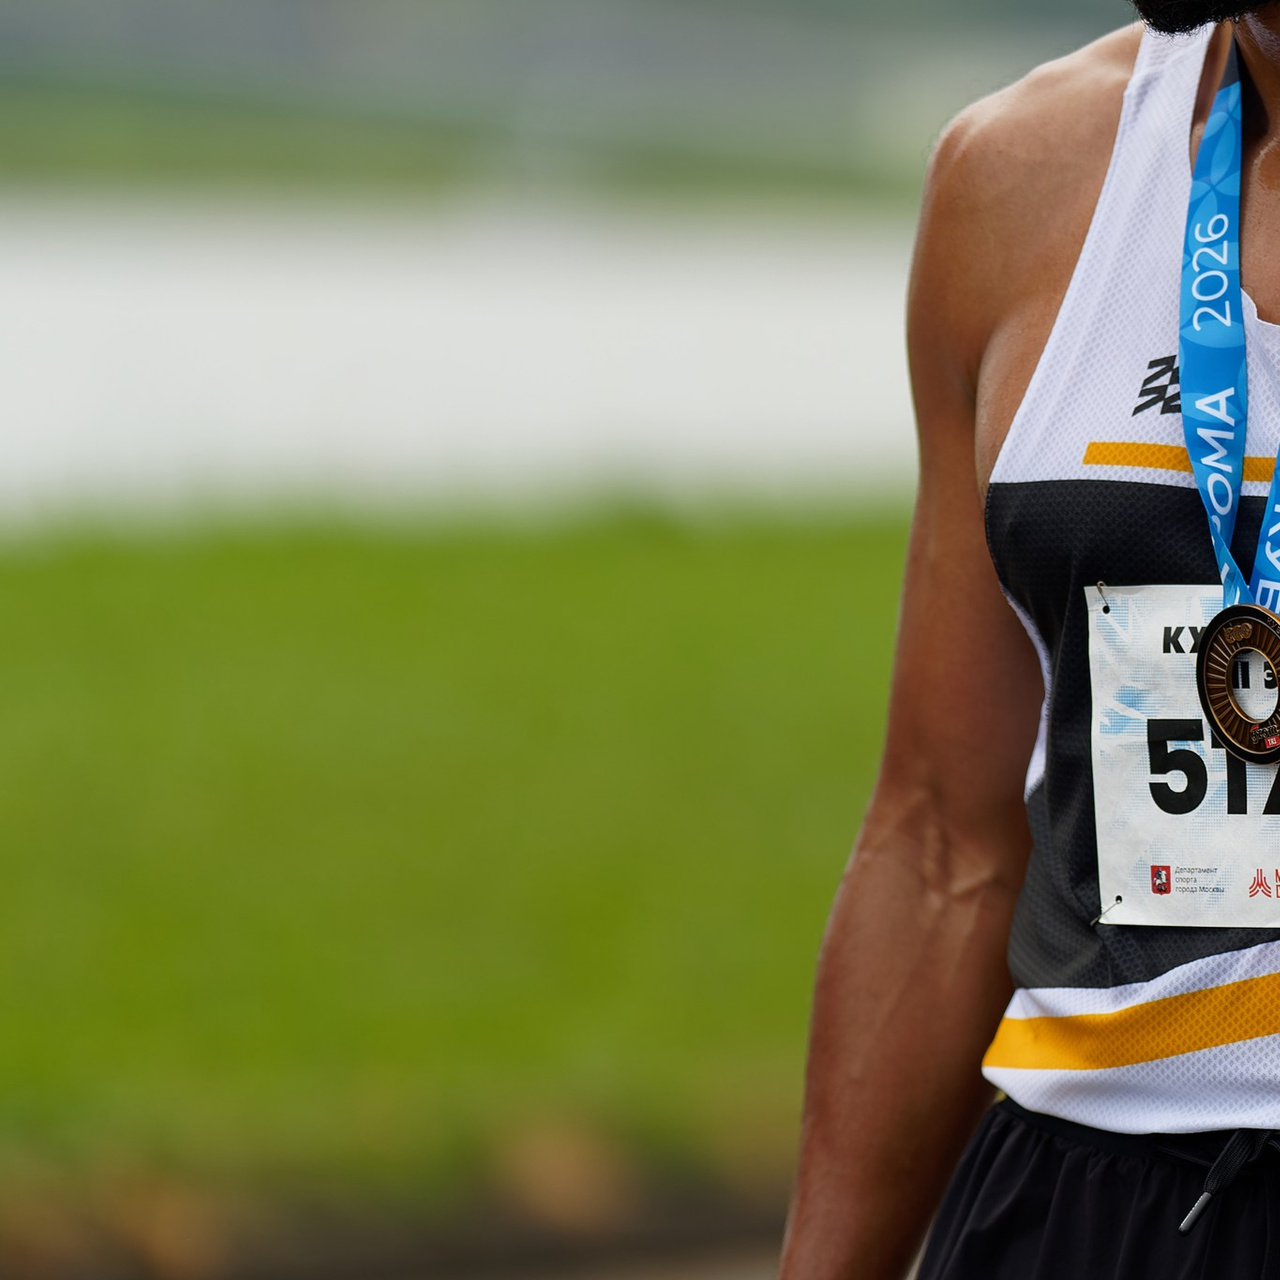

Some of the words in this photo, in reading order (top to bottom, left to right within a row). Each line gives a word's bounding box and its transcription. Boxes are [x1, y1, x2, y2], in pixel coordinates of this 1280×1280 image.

[1191, 213, 1232, 332] 2026
[1174, 866, 1218, 875] Департамент
[1175, 876, 1197, 884] спорта
[1175, 886, 1198, 894] города
